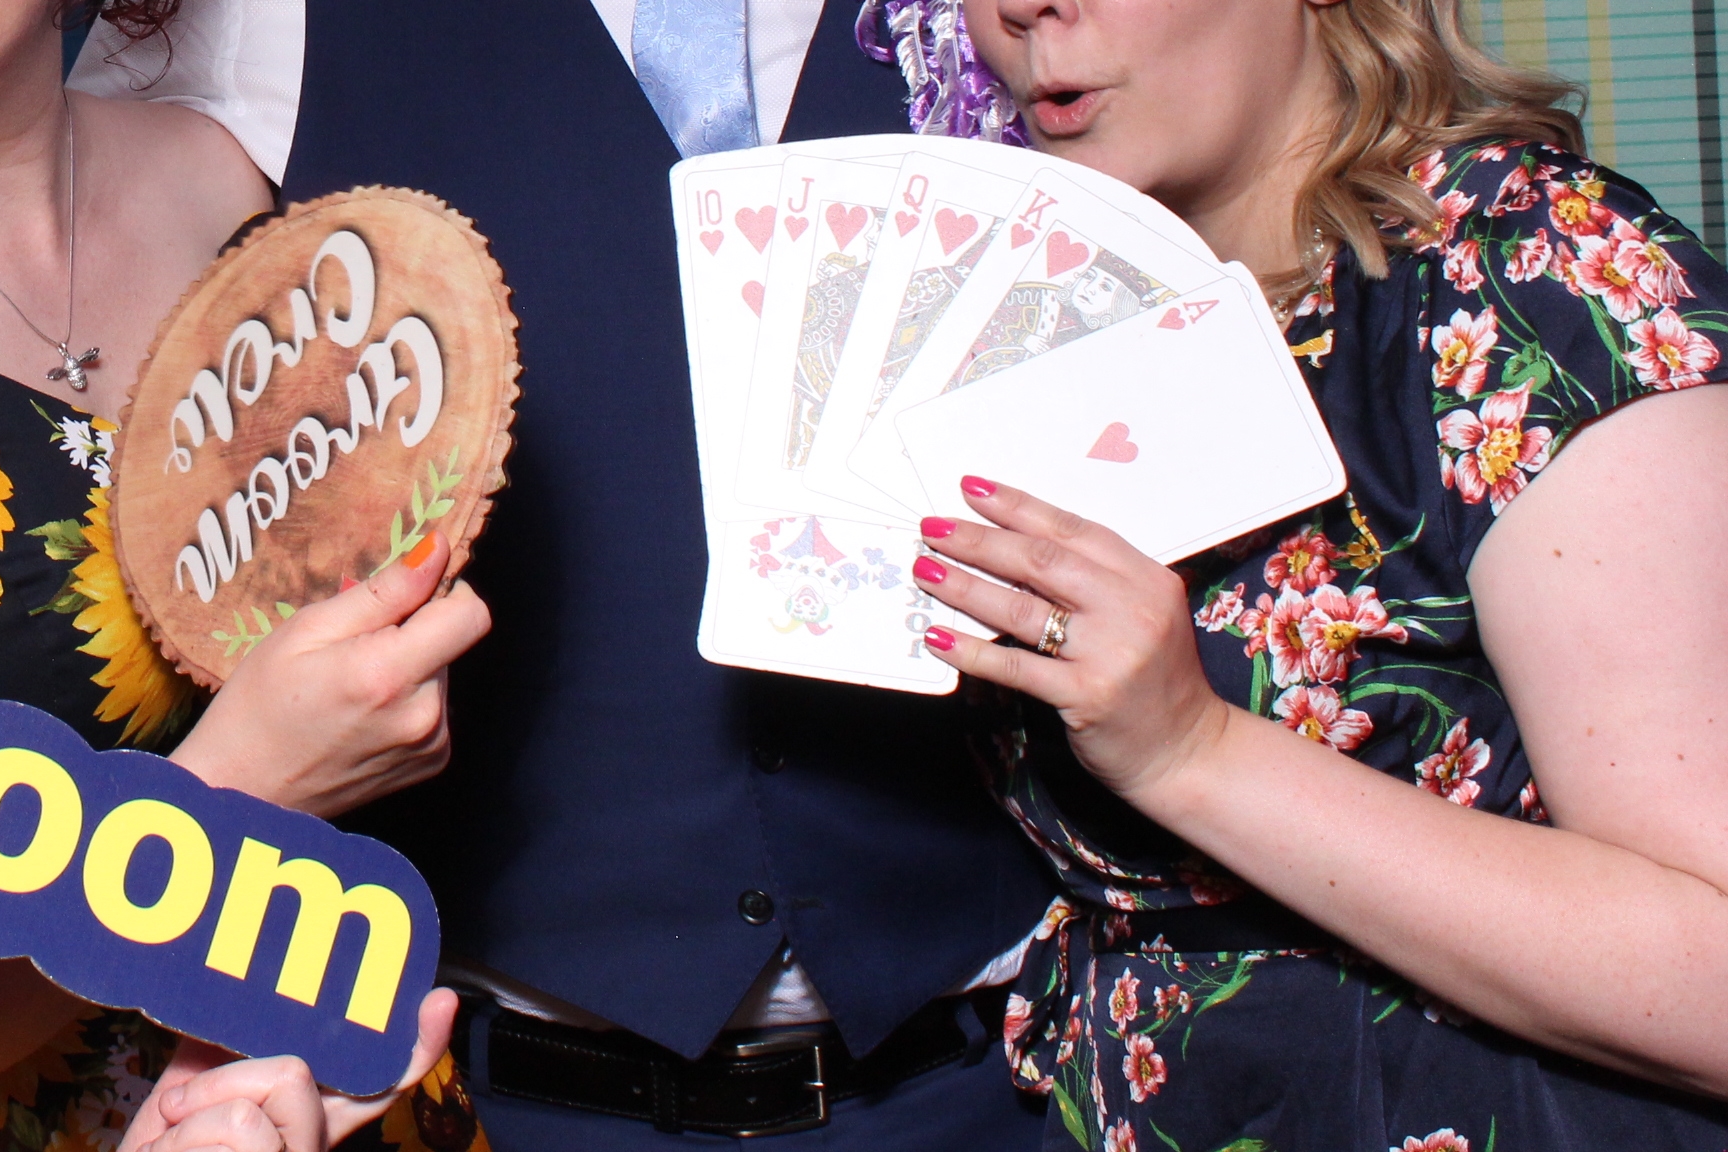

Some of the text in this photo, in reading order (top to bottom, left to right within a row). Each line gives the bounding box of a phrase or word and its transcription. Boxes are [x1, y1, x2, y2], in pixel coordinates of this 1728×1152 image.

[696, 189, 722, 226] 10
[788, 177, 814, 213] J
[903, 174, 929, 214] Q
[1025, 188, 1058, 230] K
[1183, 299, 1220, 324] A
[165, 230, 376, 474] Crew
[175, 316, 444, 604] Groom
[905, 539, 936, 659] JOK
